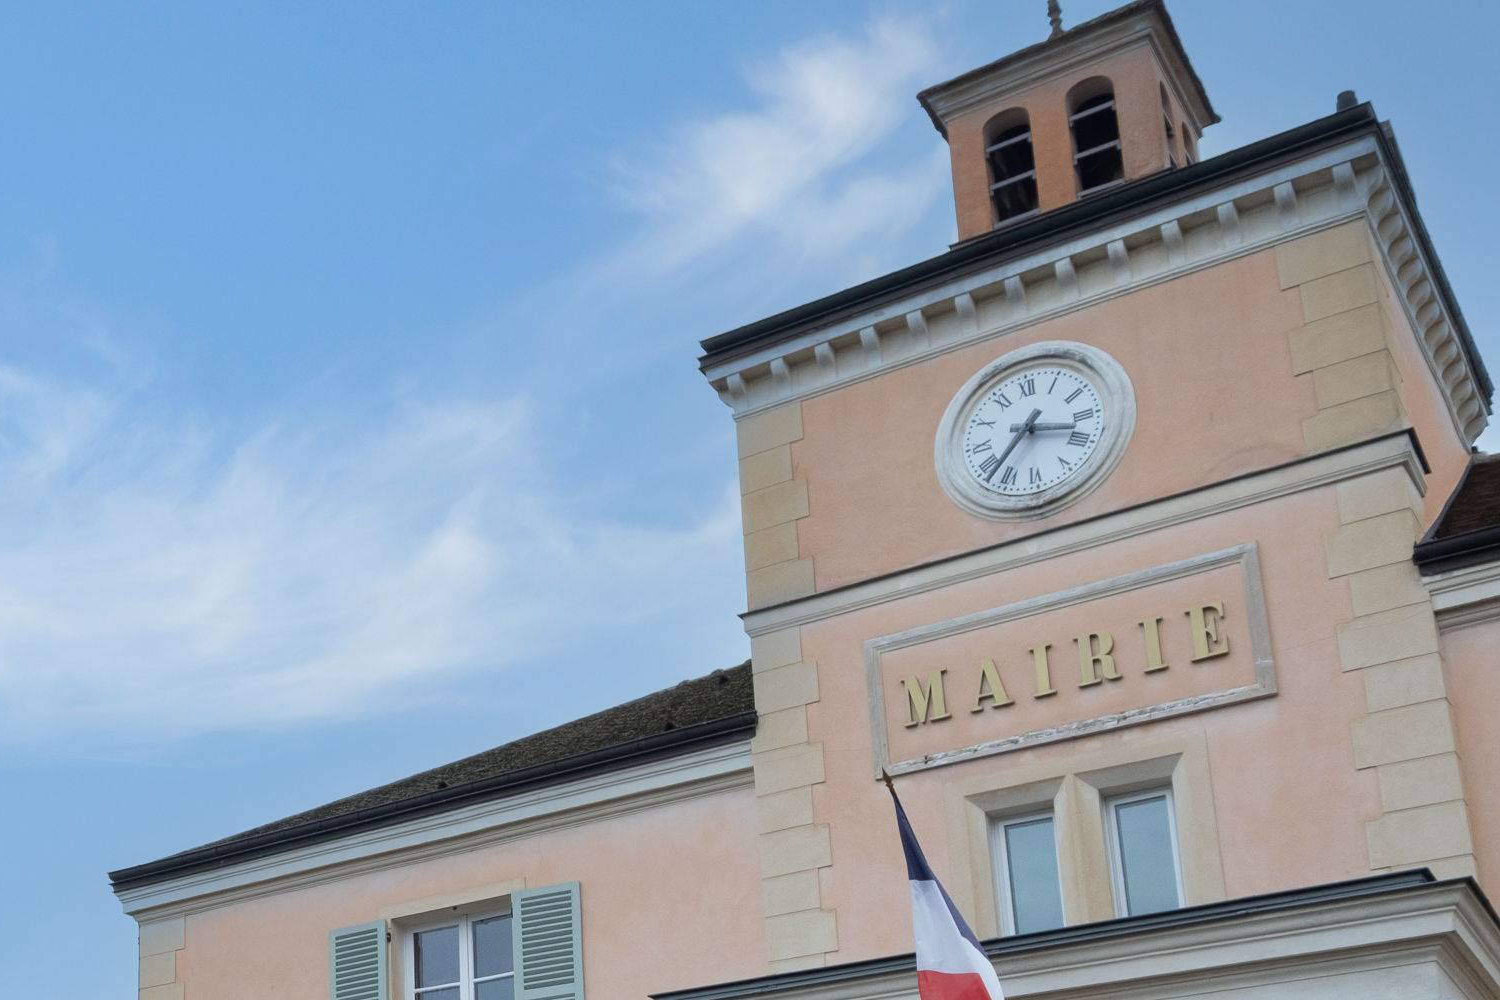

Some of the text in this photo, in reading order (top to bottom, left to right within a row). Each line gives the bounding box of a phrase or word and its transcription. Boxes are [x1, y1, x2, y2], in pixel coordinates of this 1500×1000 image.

[1018, 378, 1036, 399] XII
[1064, 388, 1084, 404] II
[993, 393, 1013, 412] XI
[1073, 408, 1094, 422] III
[976, 418, 996, 429] X
[972, 439, 993, 455] IX
[1057, 456, 1070, 469] V
[1000, 466, 1018, 486] VII
[1028, 467, 1042, 484] VI
[900, 601, 1230, 728] MAIRIE
